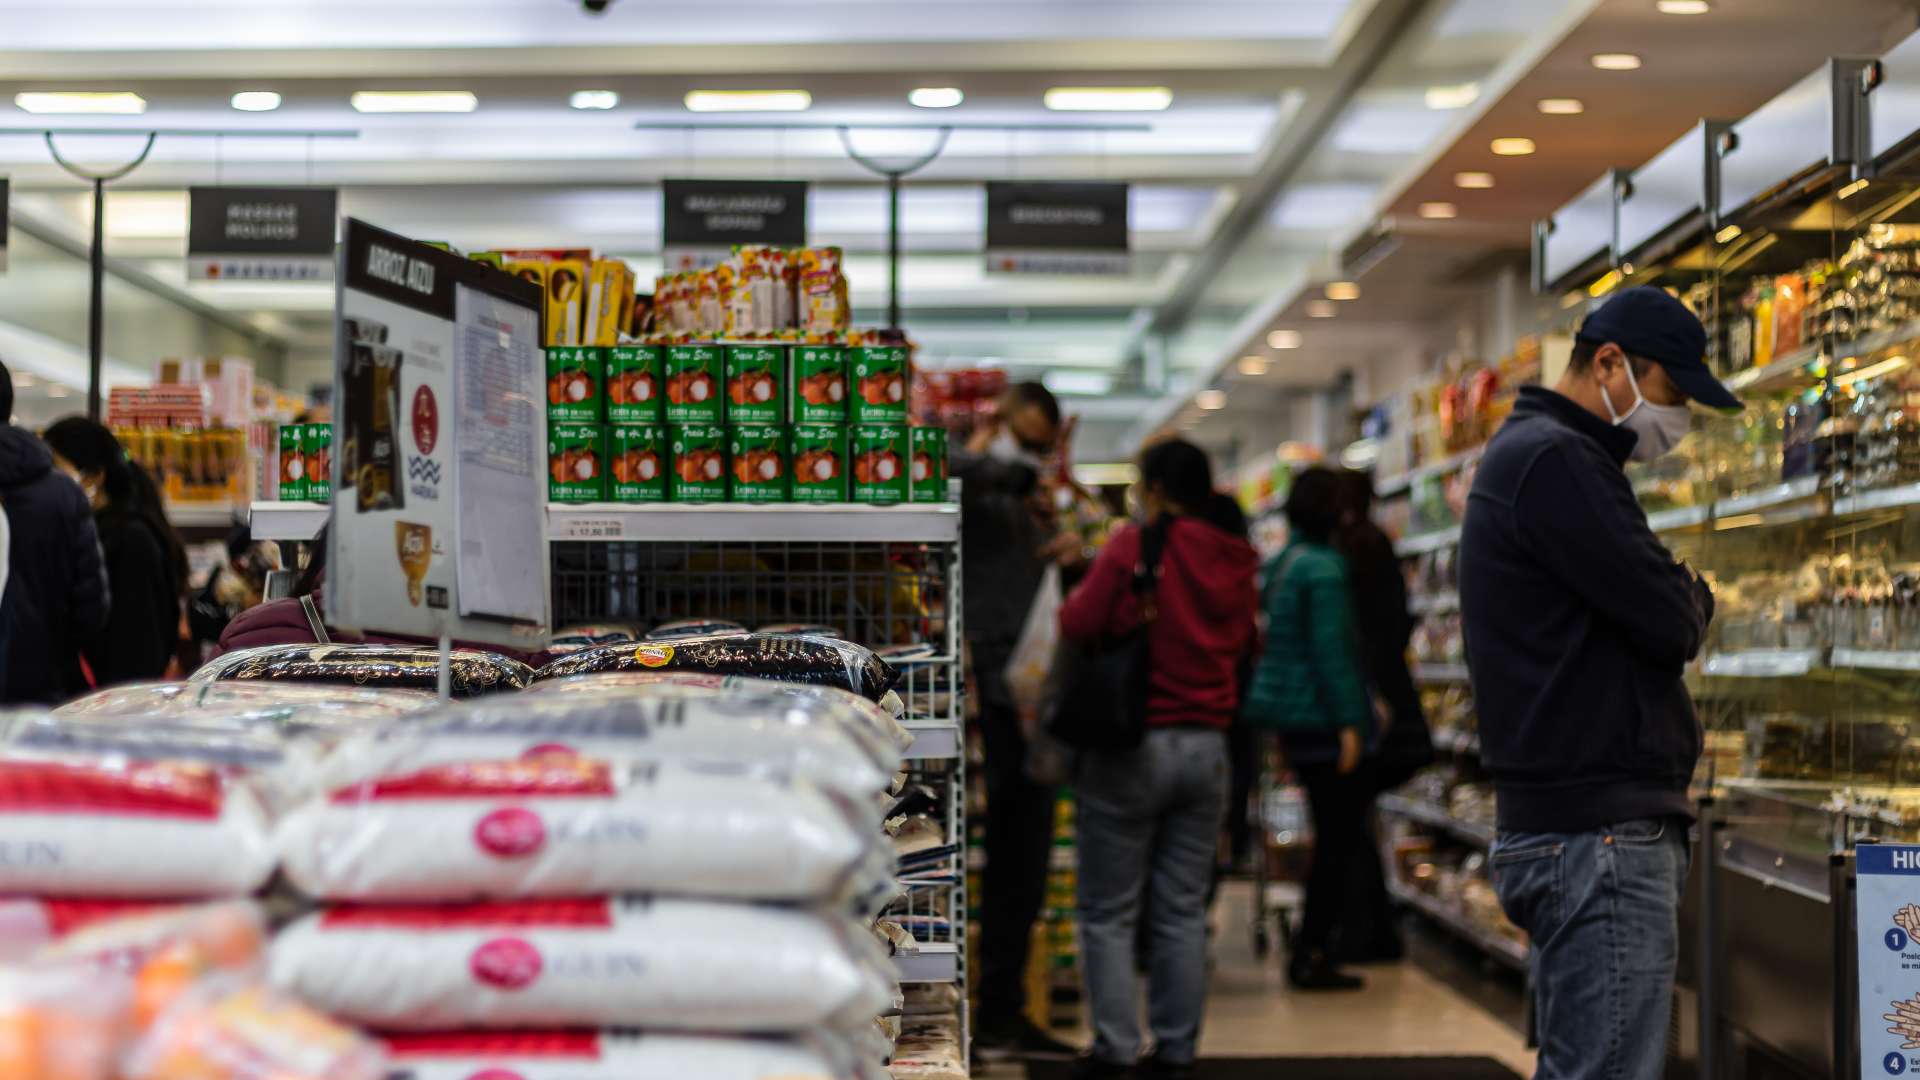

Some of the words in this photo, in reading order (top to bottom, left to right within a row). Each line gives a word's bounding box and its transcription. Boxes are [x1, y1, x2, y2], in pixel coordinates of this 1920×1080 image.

[367, 244, 407, 287] ARROZ
[406, 258, 435, 295] AIZU
[1892, 933, 1899, 947] 1
[1891, 1057, 1900, 1070] 4
